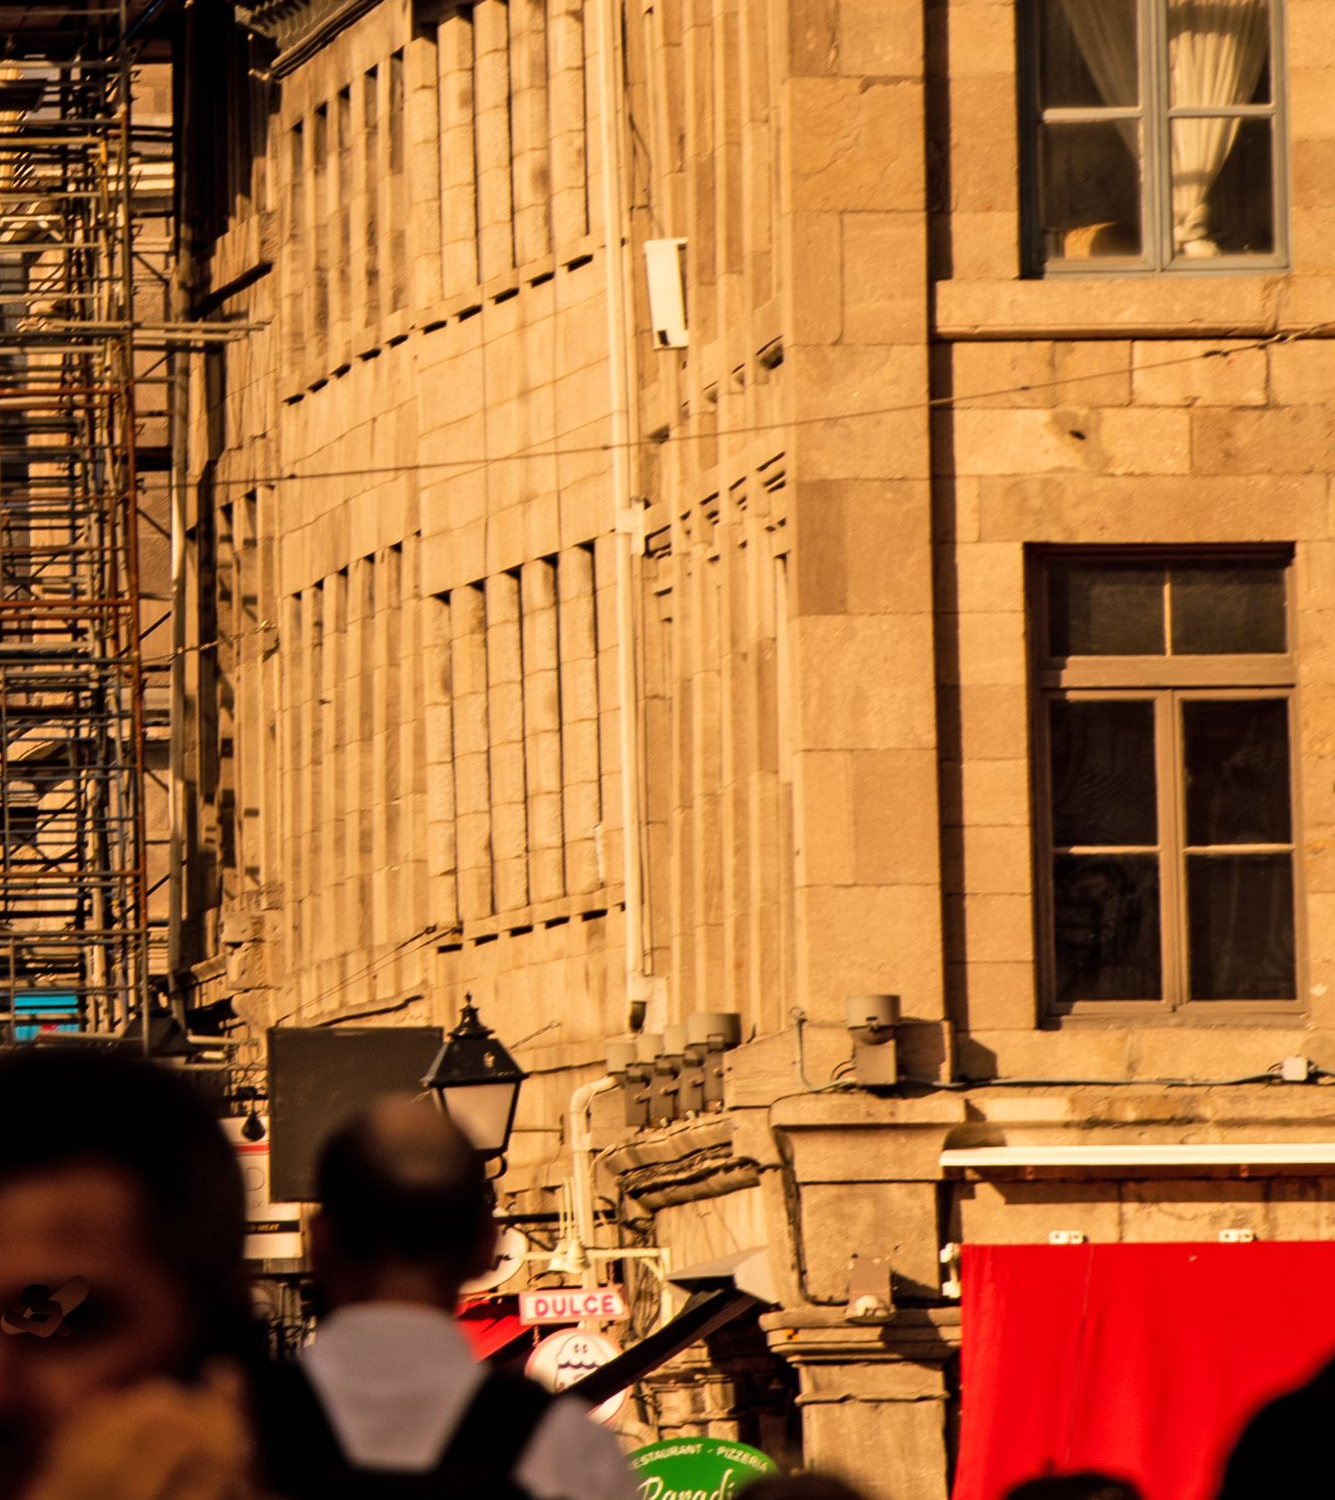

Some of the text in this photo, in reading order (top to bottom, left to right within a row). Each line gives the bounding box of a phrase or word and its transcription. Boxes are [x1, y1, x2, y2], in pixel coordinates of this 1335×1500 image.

[534, 1296, 615, 1317] DULCE
[629, 1443, 769, 1473] ESTAURANT PIZZERIA
